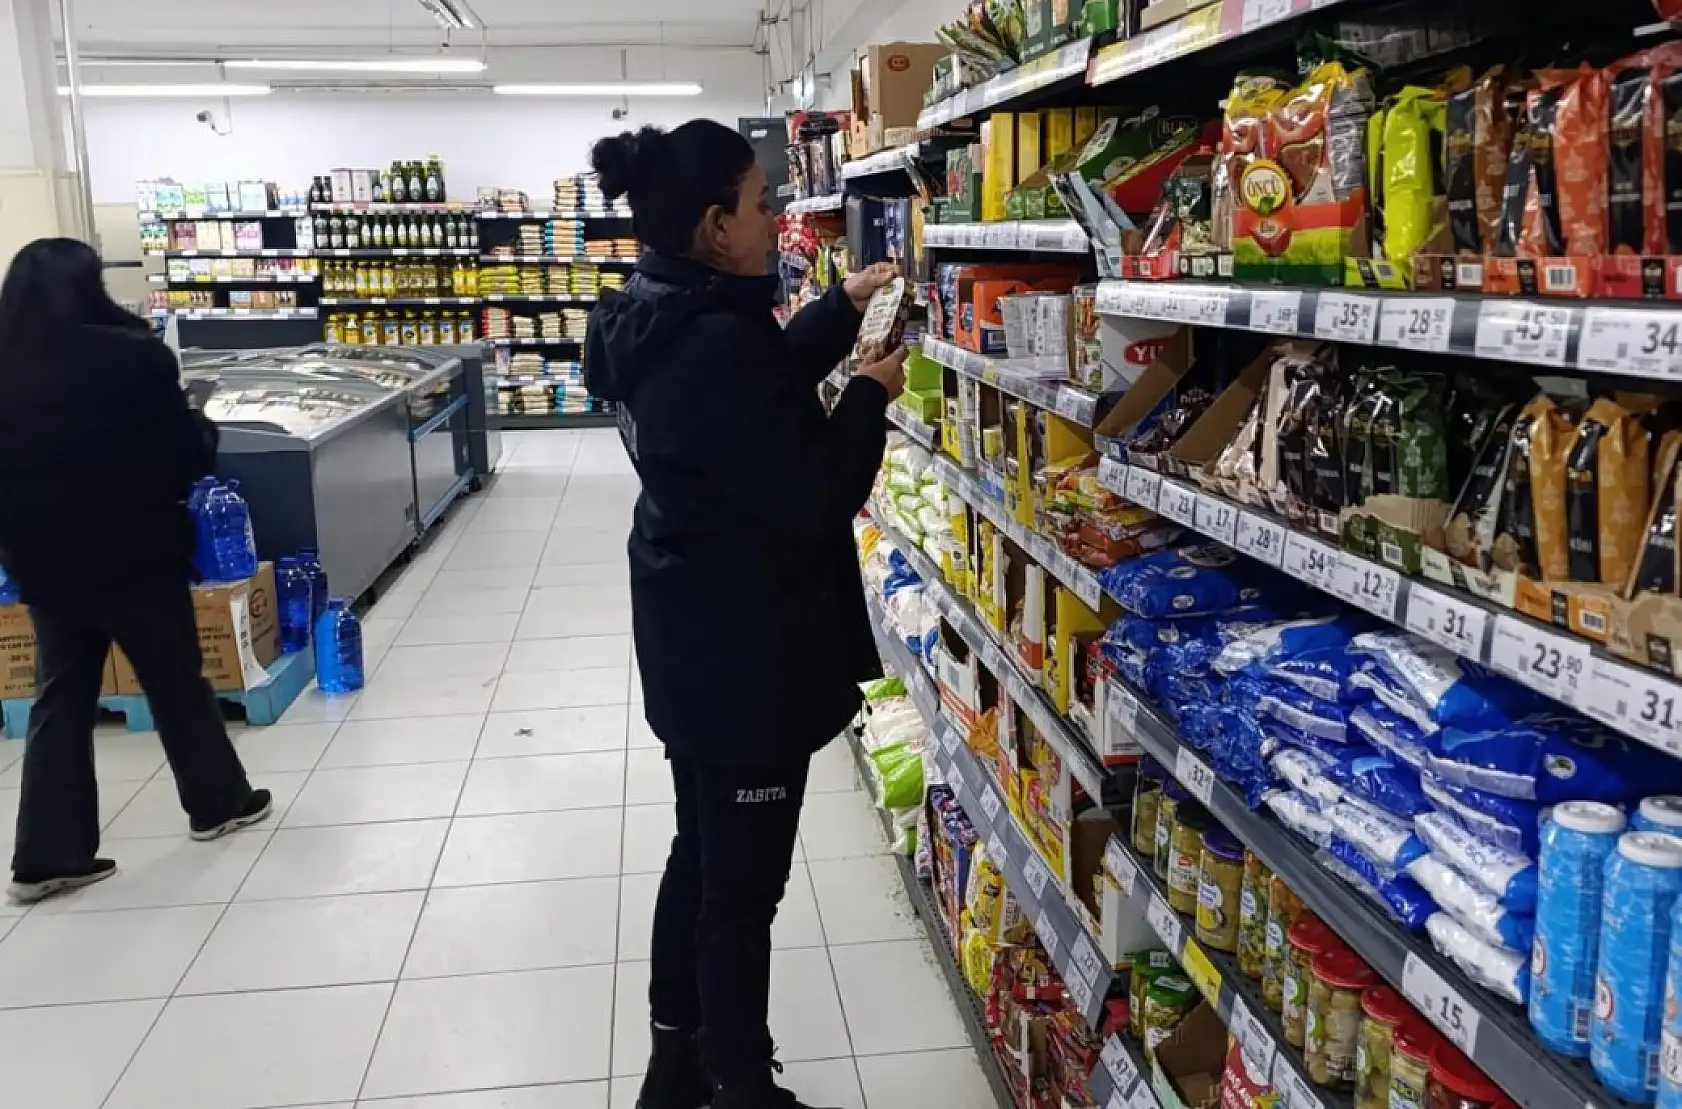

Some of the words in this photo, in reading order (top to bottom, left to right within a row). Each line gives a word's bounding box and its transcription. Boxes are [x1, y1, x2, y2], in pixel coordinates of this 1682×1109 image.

[1340, 303, 1359, 326] 35
[1408, 309, 1431, 334] 28
[1516, 311, 1545, 341] 45
[1641, 322, 1678, 355] 34
[1308, 548, 1324, 574] 54
[1362, 571, 1381, 597] 12
[1443, 608, 1466, 639] 31
[1532, 643, 1561, 679] 23
[1640, 690, 1674, 729] 31
[736, 786, 787, 803] ZABITA
[1441, 996, 1462, 1030] 15
